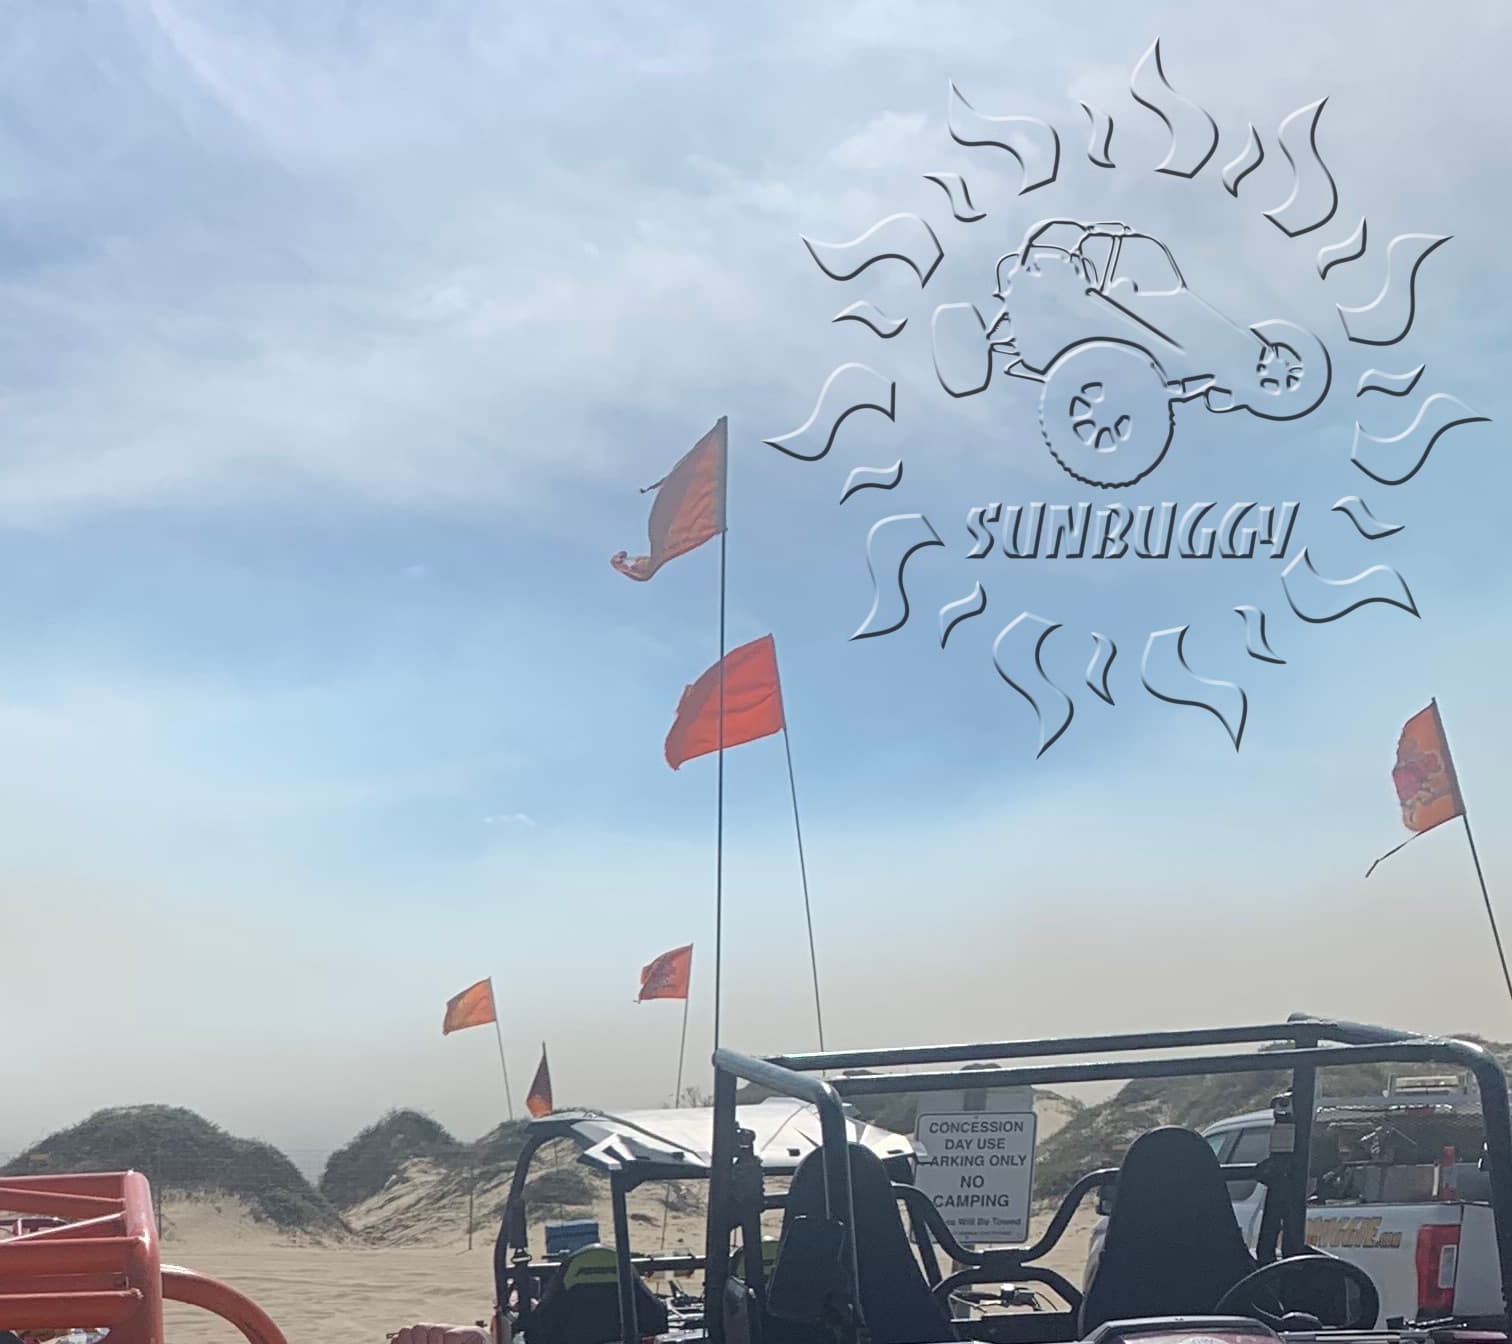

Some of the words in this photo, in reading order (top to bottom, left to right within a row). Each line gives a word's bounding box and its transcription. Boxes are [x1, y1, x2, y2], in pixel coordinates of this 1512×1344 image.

[929, 1121, 1024, 1134] CONCESSION
[944, 1138, 973, 1150] DAY
[977, 1138, 1006, 1150] USE
[929, 1155, 985, 1167] ARKING
[989, 1154, 1028, 1167] ONLY
[960, 1175, 985, 1188] NO
[933, 1194, 1009, 1209] CAMPING
